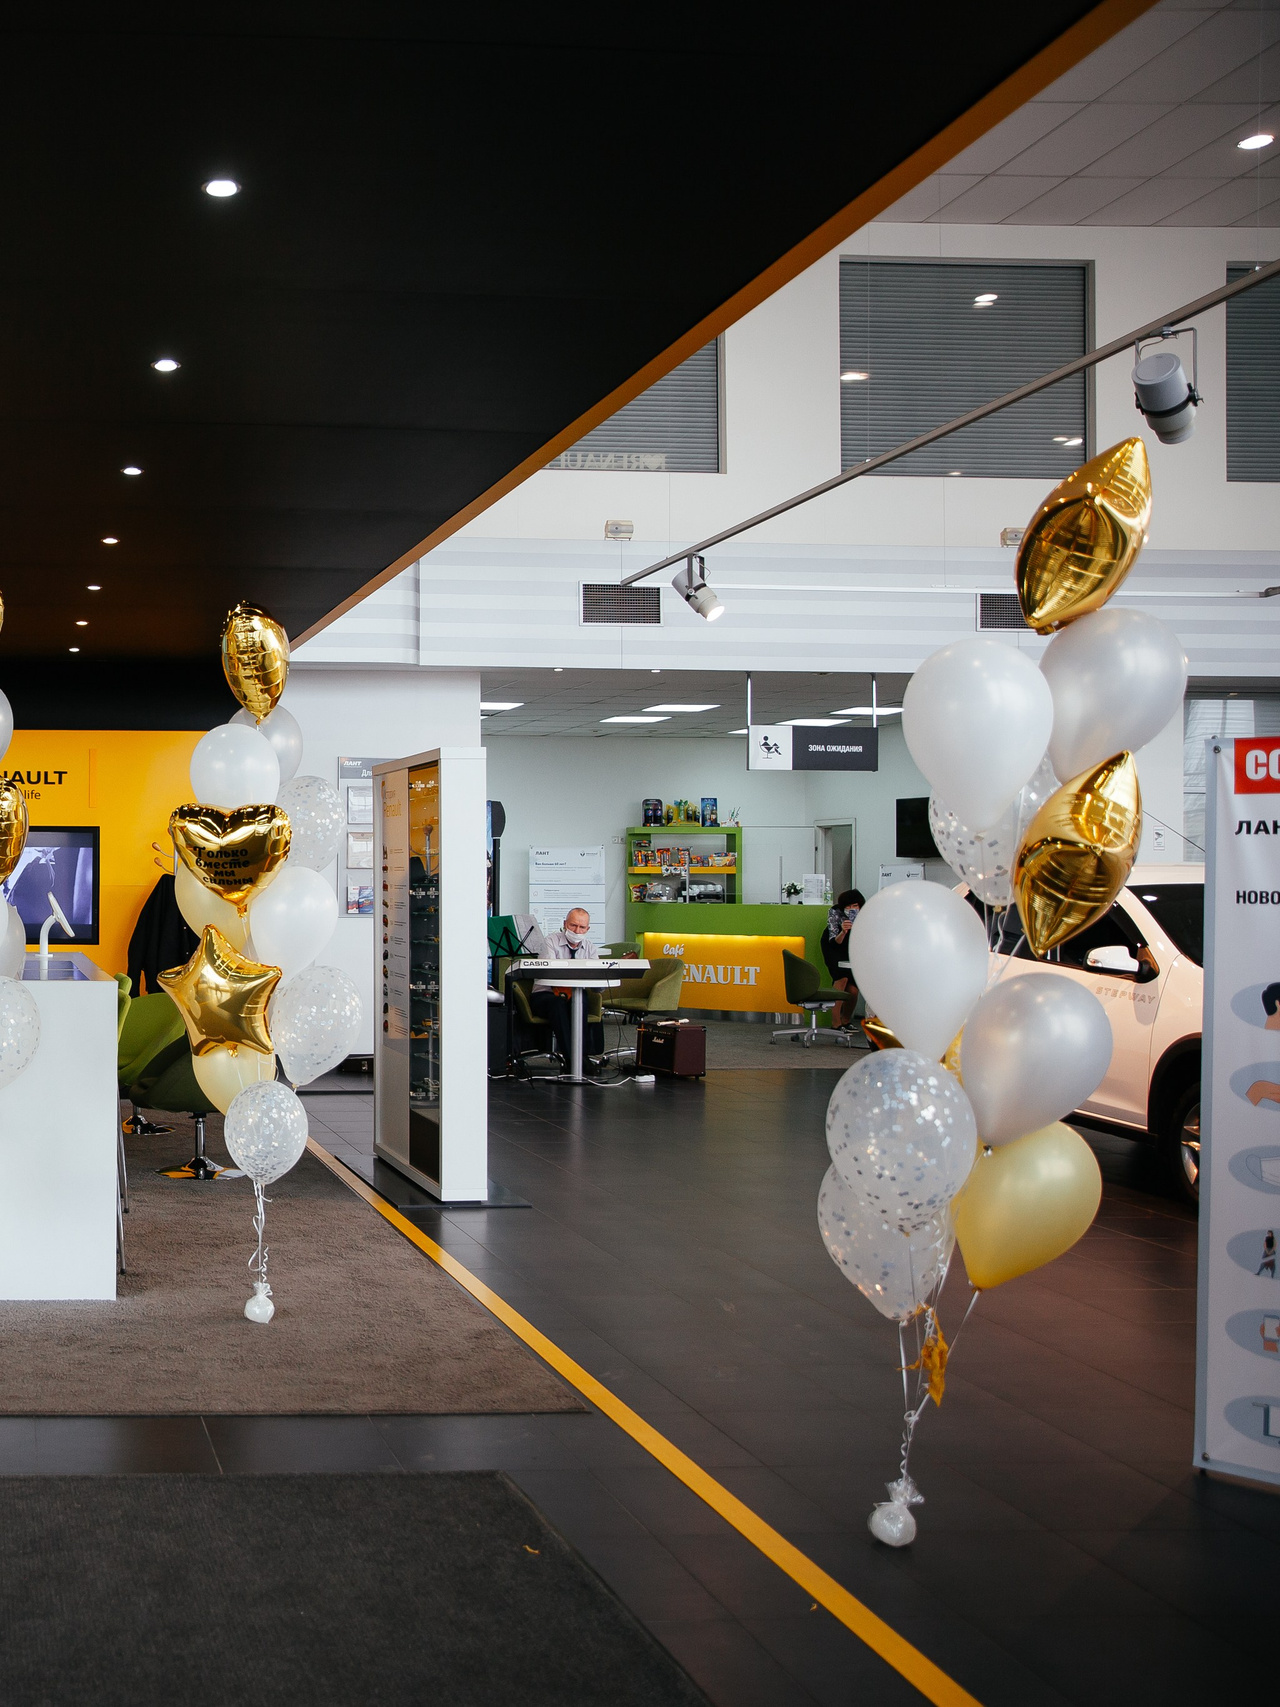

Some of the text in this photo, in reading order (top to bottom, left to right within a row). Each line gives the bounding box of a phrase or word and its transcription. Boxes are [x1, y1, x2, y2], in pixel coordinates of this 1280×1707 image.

[808, 744, 863, 753] ЗОНА ОЖИДАНИЯ
[193, 846, 249, 859] Только
[195, 858, 250, 869] вместе
[213, 869, 236, 877] мы
[202, 876, 254, 886] сильны
[663, 943, 685, 956] Café
[682, 964, 760, 986] ENAULT
[1095, 986, 1156, 1004] STEPWAY
